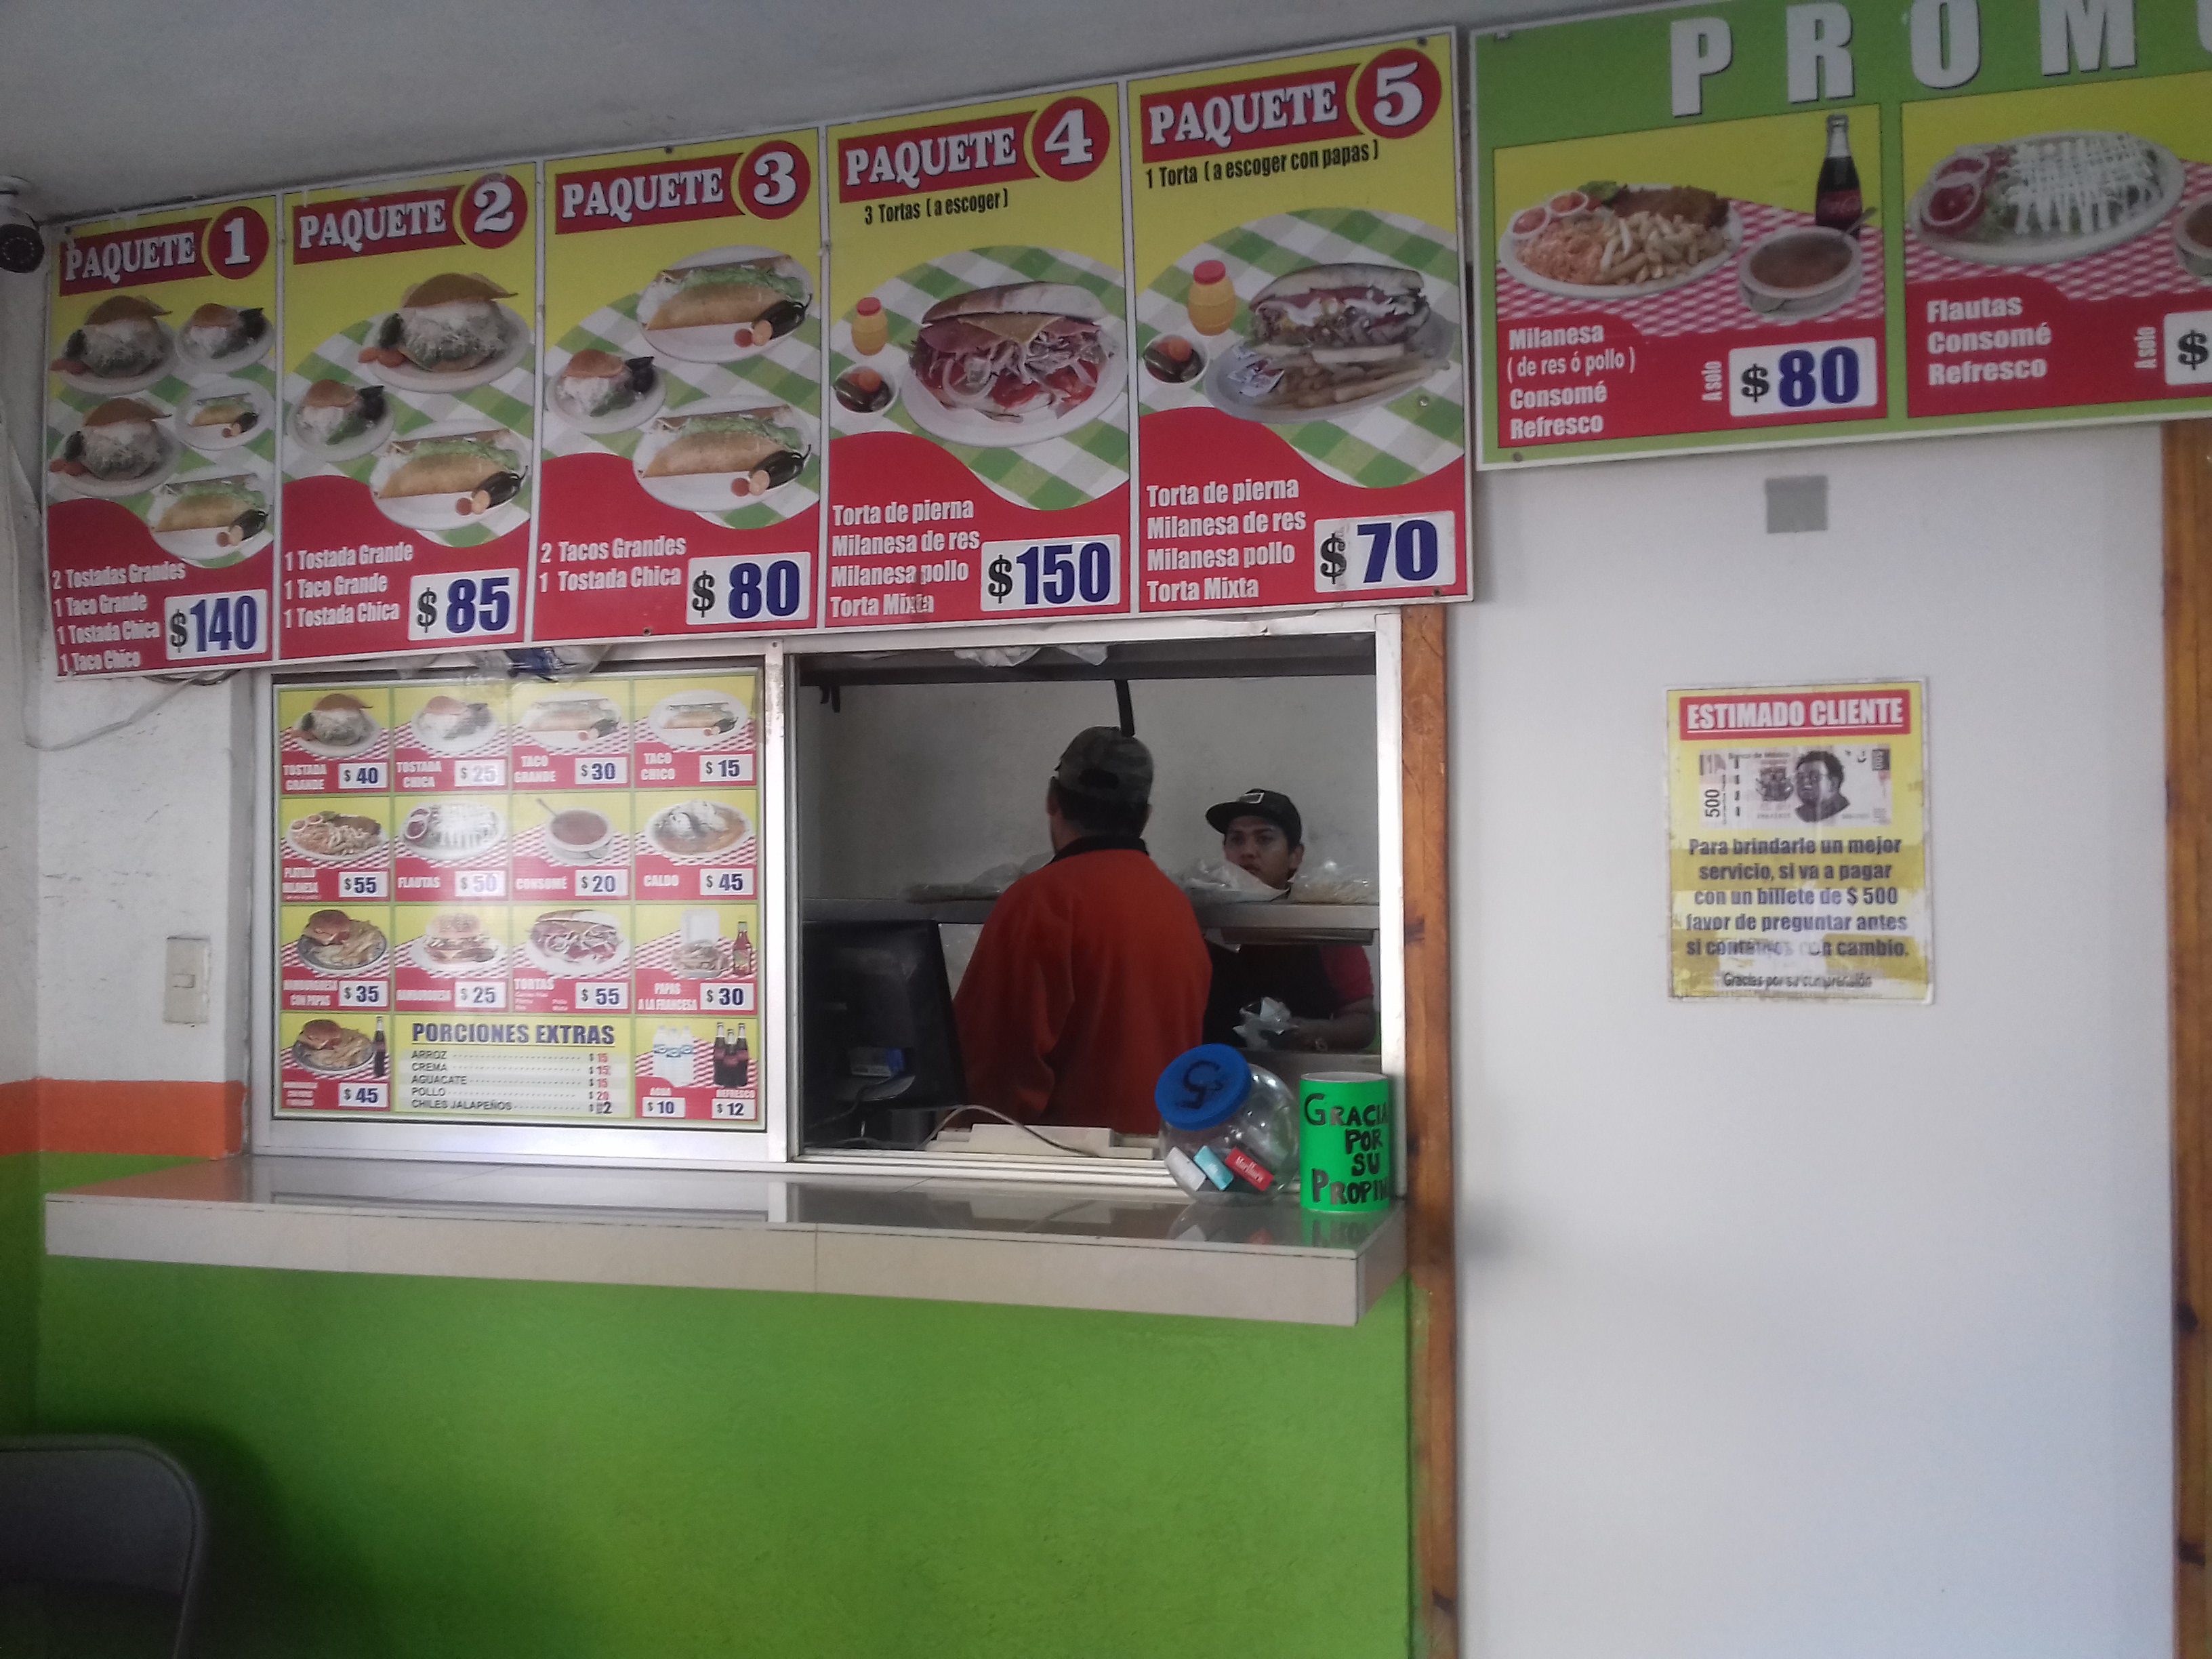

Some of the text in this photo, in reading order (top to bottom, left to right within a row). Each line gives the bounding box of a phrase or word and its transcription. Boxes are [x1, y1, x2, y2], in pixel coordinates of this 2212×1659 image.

[1148, 61, 1424, 148] PAQUETE 5
[845, 108, 1094, 190] PAQUETE 4
[1147, 169, 1154, 189] 1
[1159, 163, 1197, 188] Torta
[1225, 153, 1287, 180] escoger
[1290, 149, 1319, 169] con
[562, 151, 797, 223] PAQUETE 3
[299, 181, 514, 253] PAQUETE 2
[865, 205, 874, 226] 3
[880, 200, 920, 224] Tortas
[65, 217, 251, 284] PAQUETE 1
[1927, 297, 2023, 323] Flautas
[1509, 325, 1605, 351] Milanesa
[1927, 322, 2052, 354] Consomé
[1540, 352, 1566, 375] res
[1929, 359, 2047, 386] Refresco
[1509, 381, 1608, 411] Consomé
[1510, 415, 1604, 441] Refresco
[1147, 478, 1299, 508] Torta de pierna
[832, 498, 975, 527] Torta de pierna
[1147, 510, 1306, 539] Milanesa de res
[285, 542, 413, 571] 1 Tostada Grande
[541, 534, 687, 564] 2 Tacos Grandes
[832, 530, 980, 557] Milanesa de res
[1147, 541, 1296, 571] Milanesa pollo
[52, 561, 186, 590] 2 Tostadas Grandes
[284, 573, 388, 600] 1 Taco Grande
[539, 565, 682, 592] 1 Tostada Chica
[831, 559, 969, 588] Milanesa pollo
[1147, 577, 1259, 602] Torta Mixta
[54, 599, 62, 617] 1
[284, 602, 401, 628] 1 Tostada Chica
[830, 593, 934, 618] Torta Mixta
[57, 627, 65, 645] 1
[60, 654, 68, 672] 1
[1687, 697, 1903, 730] ESTIMADO CLIENTE
[1705, 790, 1720, 817] 500
[1689, 836, 1902, 856] Para brindarle un mejor
[1699, 863, 1892, 881] servicio, si va a pagar
[1694, 889, 1727, 906] con
[1731, 889, 1753, 905] un
[1757, 887, 1816, 905] billete
[1819, 888, 1842, 905] de
[1685, 913, 1908, 932] favor de preguntar antes
[1686, 939, 1702, 956] si
[412, 1023, 615, 1044] PORCIONES EXTRAS
[411, 1051, 448, 1059] ARROZ
[411, 1063, 448, 1071] CREMA
[411, 1075, 467, 1084] AGUACATE
[411, 1088, 446, 1097] POLLO
[411, 1098, 512, 1110] CHILES JALAPEÑOS
[1345, 1129, 1382, 1154] POR
[1351, 1153, 1380, 1176] SU
